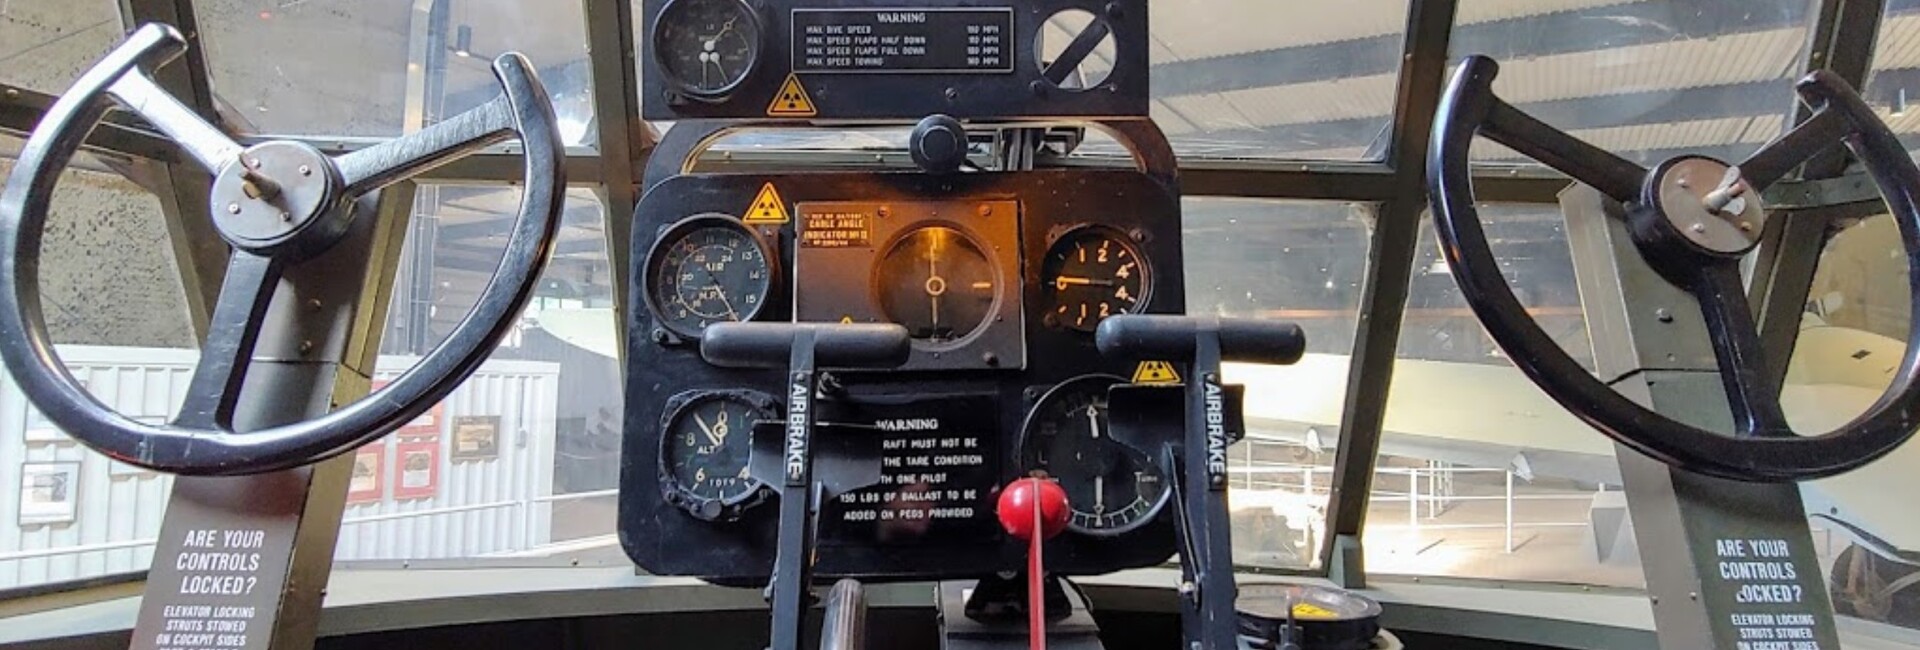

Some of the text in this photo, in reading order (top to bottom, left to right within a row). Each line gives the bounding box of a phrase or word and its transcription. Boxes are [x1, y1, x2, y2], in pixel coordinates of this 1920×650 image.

[877, 12, 926, 23] WARNING
[806, 25, 822, 34] MAX
[847, 25, 871, 34] SPEED
[983, 25, 999, 34] MPH
[806, 36, 822, 45] MAX
[826, 36, 850, 45] SPEED
[855, 36, 877, 45] FLAPS
[882, 36, 899, 45] HALF
[904, 36, 926, 45] DOWN
[983, 36, 999, 44] MPH
[806, 47, 822, 55] MAX
[826, 47, 850, 55] SPEED
[855, 47, 877, 55] FLAPS
[882, 47, 899, 55] FULL
[902, 47, 925, 55] DOWN
[983, 47, 999, 55] MPH
[806, 58, 822, 66] MAX
[826, 58, 850, 66] SPEED
[855, 58, 883, 66] TOWING
[983, 58, 999, 66] MPH
[809, 220, 864, 228] CABLE ANGLE
[804, 231, 846, 239] INDICATOR
[742, 252, 752, 260] 13
[1080, 248, 1085, 262] 1
[1098, 248, 1107, 262] 2
[705, 262, 724, 271] AIR
[1115, 265, 1130, 279] 4
[1115, 285, 1129, 300] 4
[1081, 304, 1086, 318] 1
[1100, 303, 1109, 317] 2
[787, 384, 807, 475] AIRBRAKE
[876, 419, 938, 431] WARNING
[1205, 383, 1225, 474] AIRBRAKE
[686, 433, 696, 446] 8
[883, 438, 977, 449] RAFT MUST NOT BE
[697, 445, 714, 454] ALT
[884, 455, 982, 467] THE TARE CONDITION
[695, 468, 705, 482] 6
[738, 466, 750, 480] 4
[896, 474, 916, 484] ONE
[921, 473, 947, 483] PILOT
[860, 492, 879, 503] LBS
[884, 492, 896, 502] OF
[902, 491, 942, 502] BALLAST
[947, 491, 959, 500] TO
[964, 489, 977, 500] BE
[844, 508, 974, 520] ADDED ON PEGS PROVIDED
[184, 530, 265, 548] ARE YOUR
[1716, 540, 1789, 557] ARE YOUR
[176, 553, 260, 571] CONTROLS
[1720, 562, 1796, 579] CONTROLS
[180, 576, 257, 594] LOCKED?
[164, 606, 255, 618] ELEVATOR LOCKING
[1731, 614, 1815, 625] ELEVATOR LOCKING
[166, 620, 246, 632] STRUTS STOWED
[1740, 628, 1813, 639] STRUTS STOWED
[156, 634, 247, 646] ON COCKPIT SIDES
